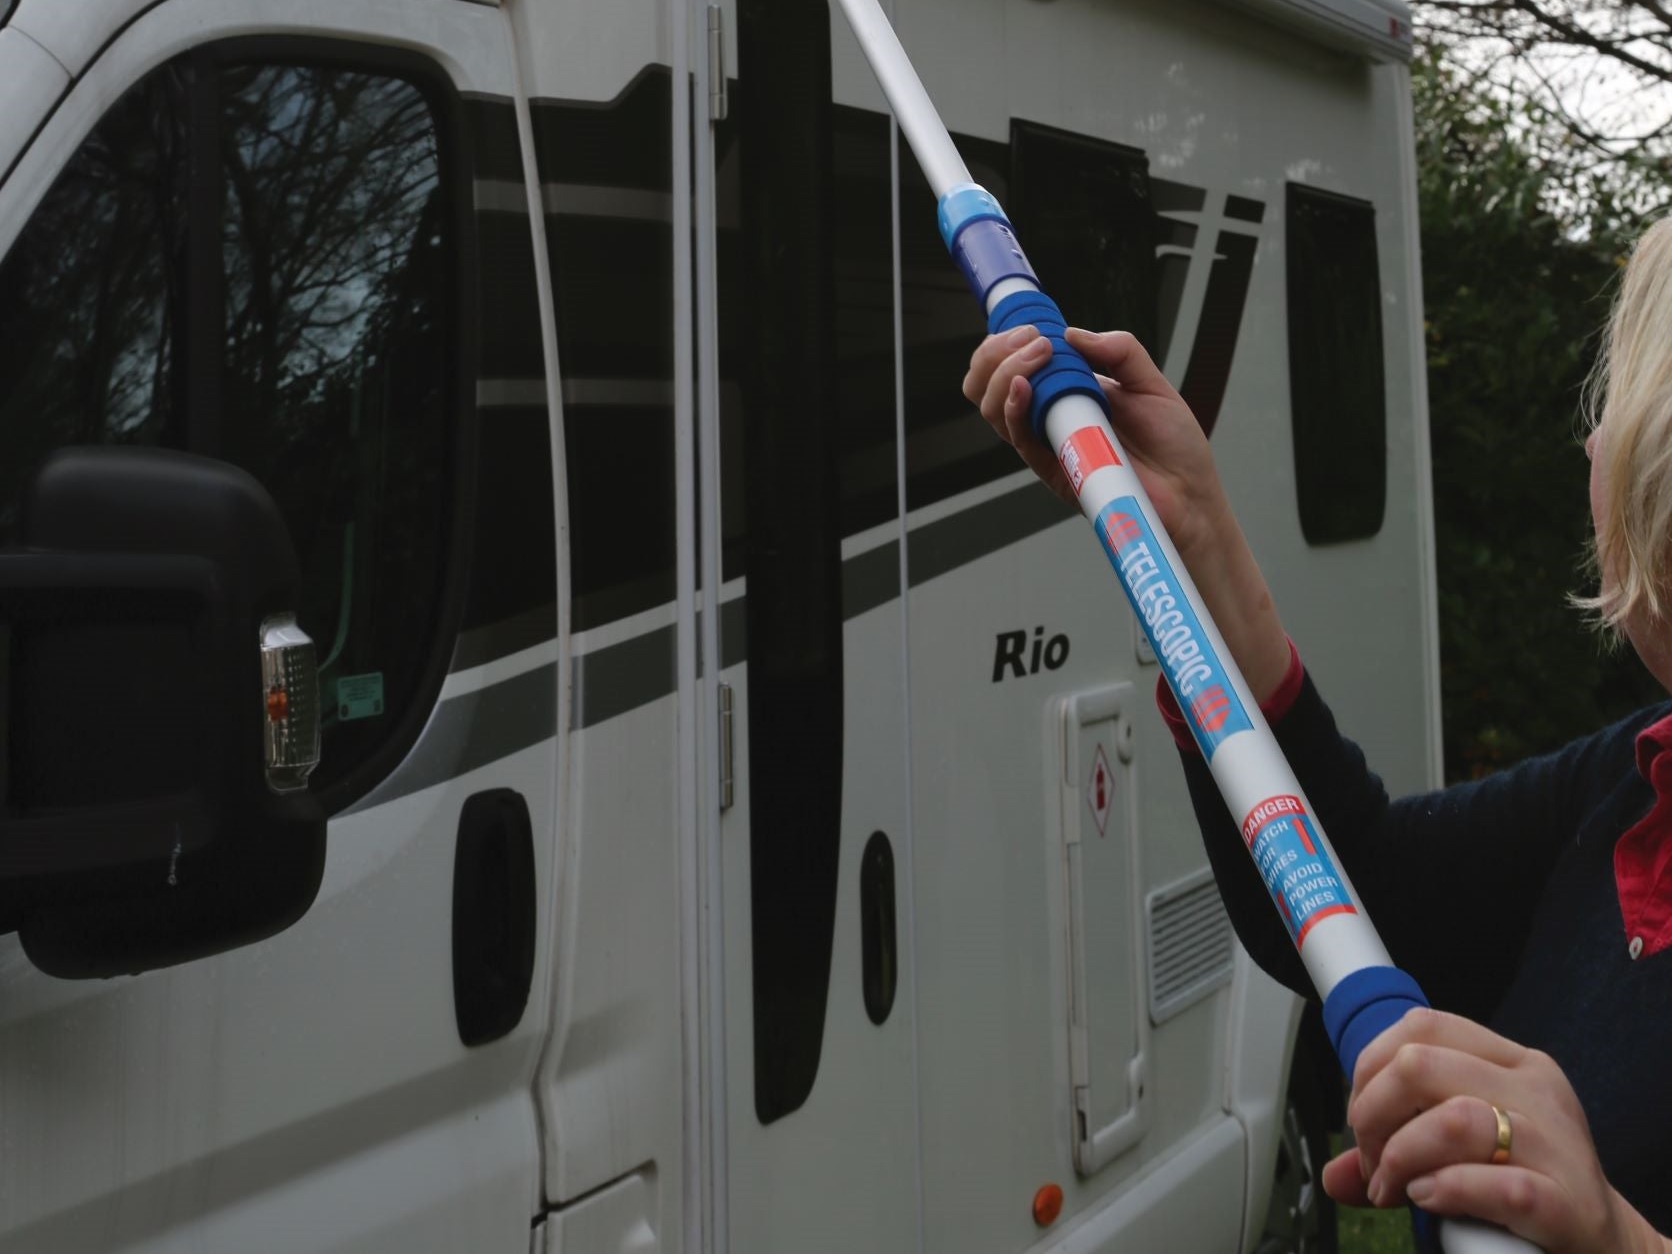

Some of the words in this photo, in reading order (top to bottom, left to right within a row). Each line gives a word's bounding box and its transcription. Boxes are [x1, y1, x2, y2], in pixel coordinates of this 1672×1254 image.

[1120, 542, 1212, 695] TELESCOPIC
[992, 625, 1070, 684] Rio
[1244, 797, 1299, 843] DANGER
[1253, 820, 1289, 859] WATCH
[1267, 849, 1298, 889] WIRES
[1282, 862, 1323, 892] AVOID
[1288, 876, 1338, 907] POWER
[1295, 890, 1335, 922] LINES
